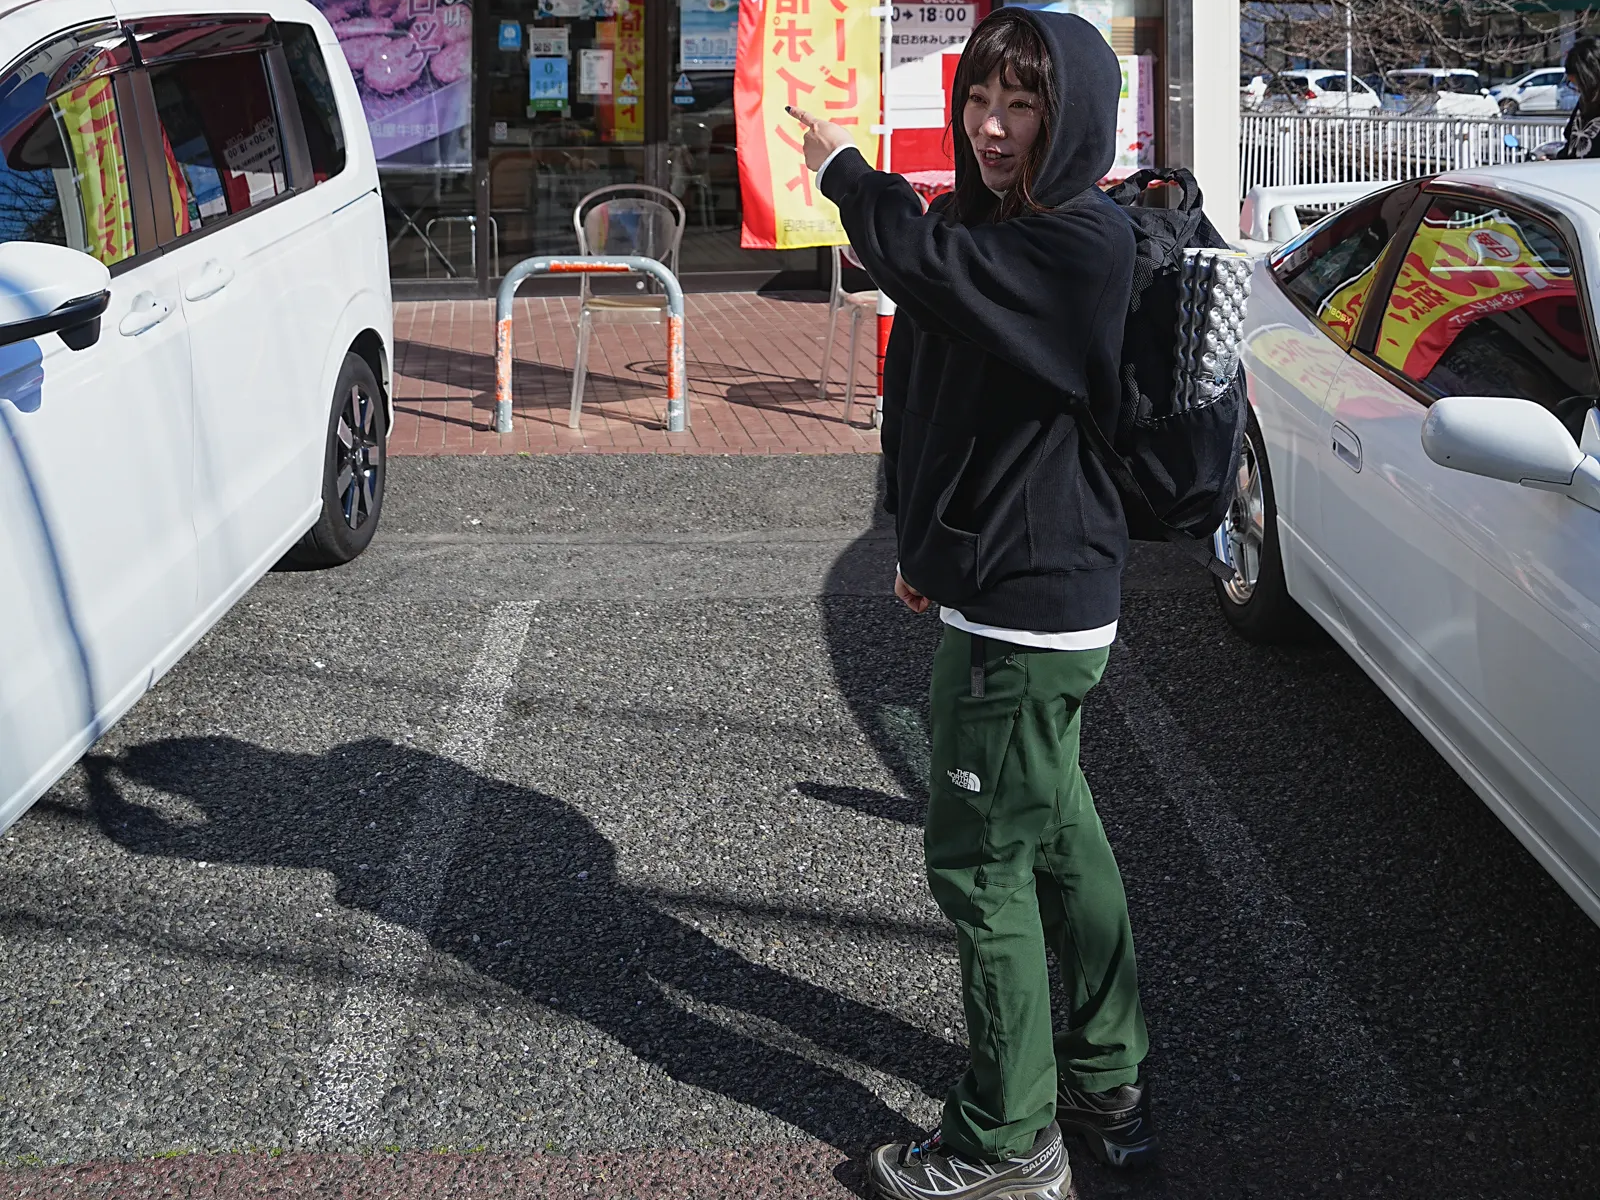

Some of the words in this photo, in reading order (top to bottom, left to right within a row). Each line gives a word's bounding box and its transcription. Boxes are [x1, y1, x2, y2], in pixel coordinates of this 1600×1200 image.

[919, 7, 966, 22] 18:00
[946, 769, 969, 783] NORTH
[956, 768, 970, 778] THE
[951, 778, 968, 789] FACE
[1021, 1132, 1062, 1175] SALOMON
